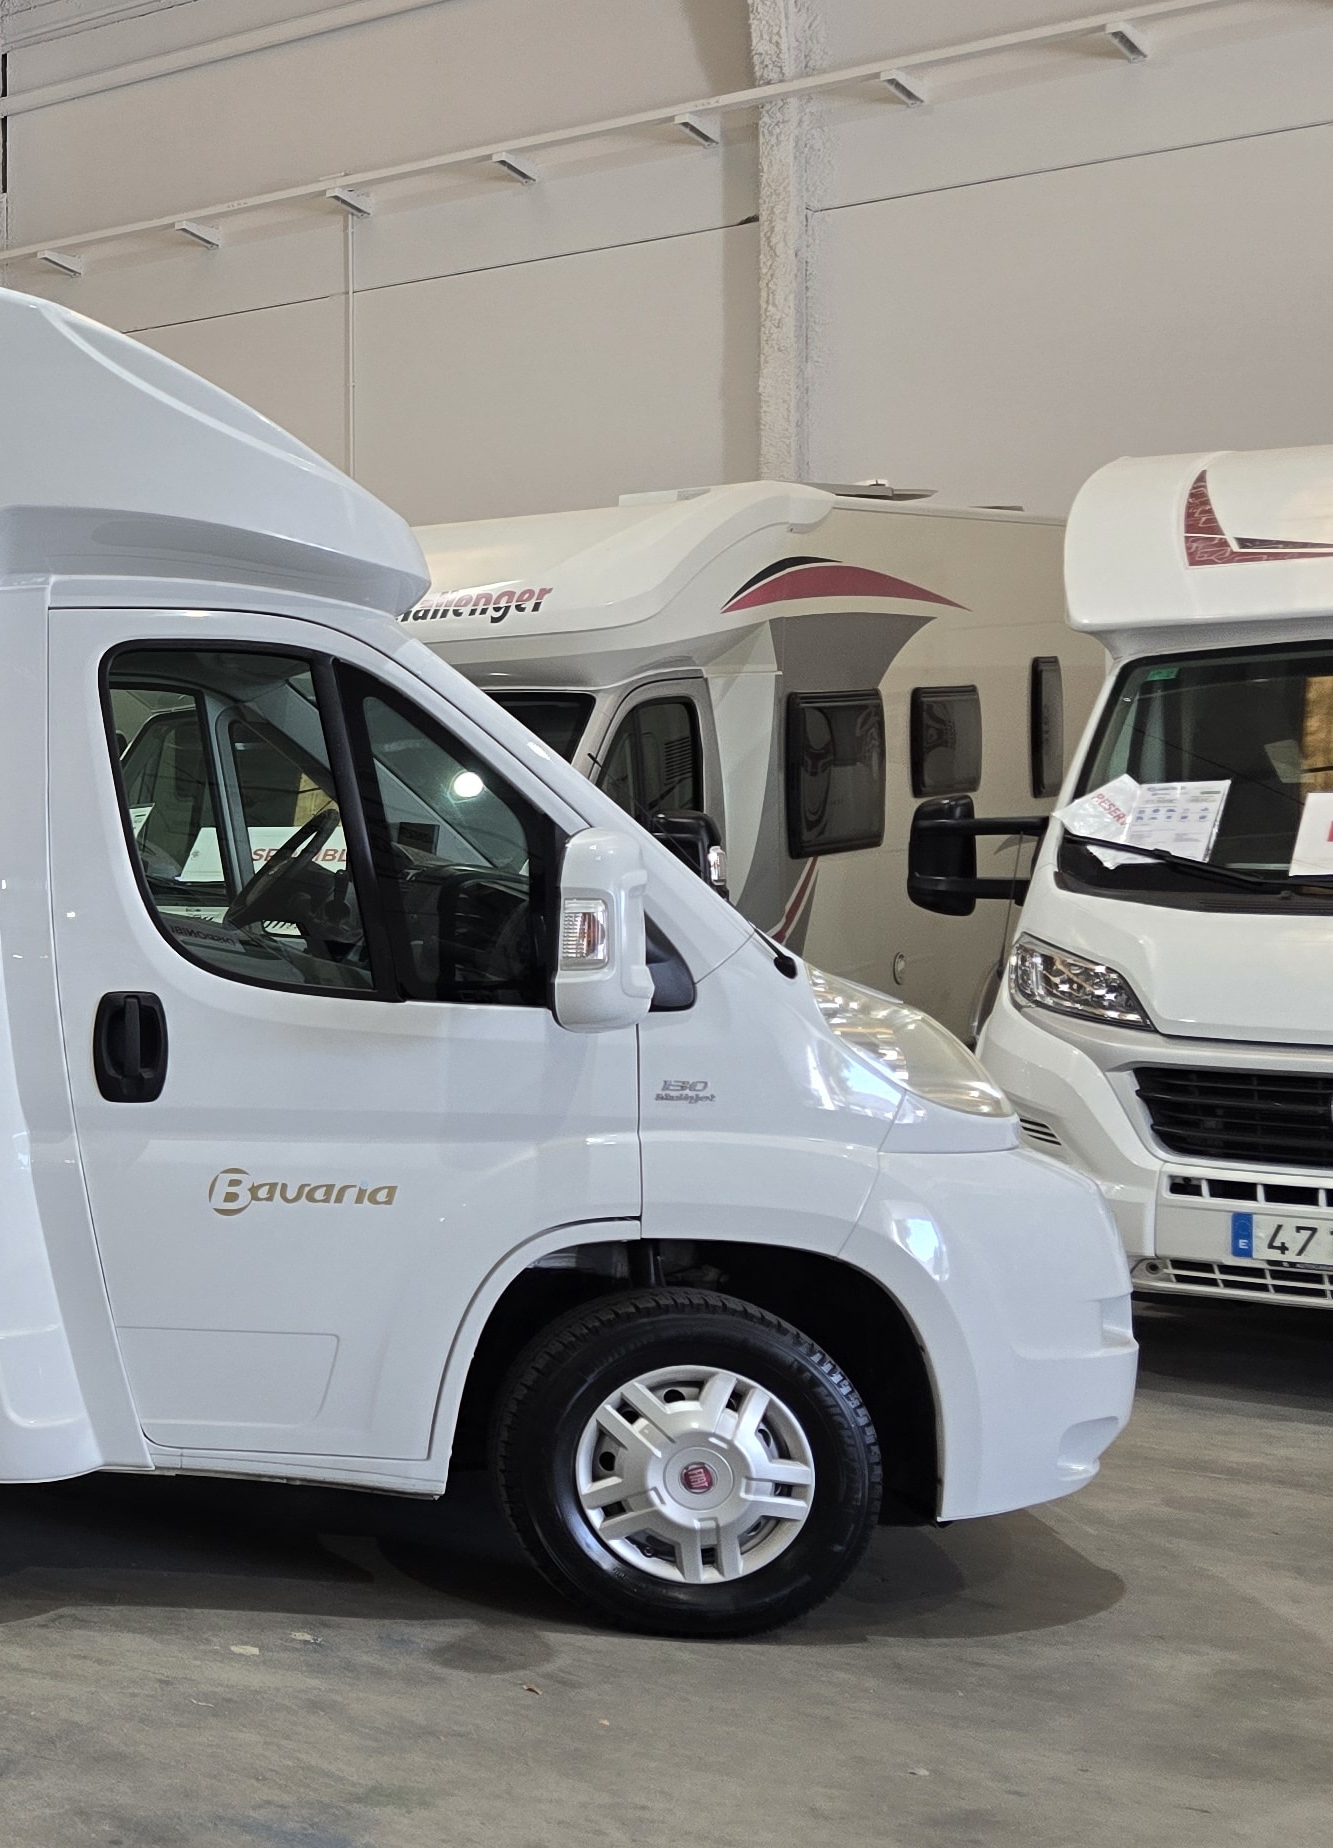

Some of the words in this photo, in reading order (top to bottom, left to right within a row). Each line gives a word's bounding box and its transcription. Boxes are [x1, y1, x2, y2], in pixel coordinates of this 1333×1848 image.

[208, 1167, 399, 1217] Bavaria
[1238, 1239, 1249, 1249] E
[687, 1468, 709, 1488] FIAT
